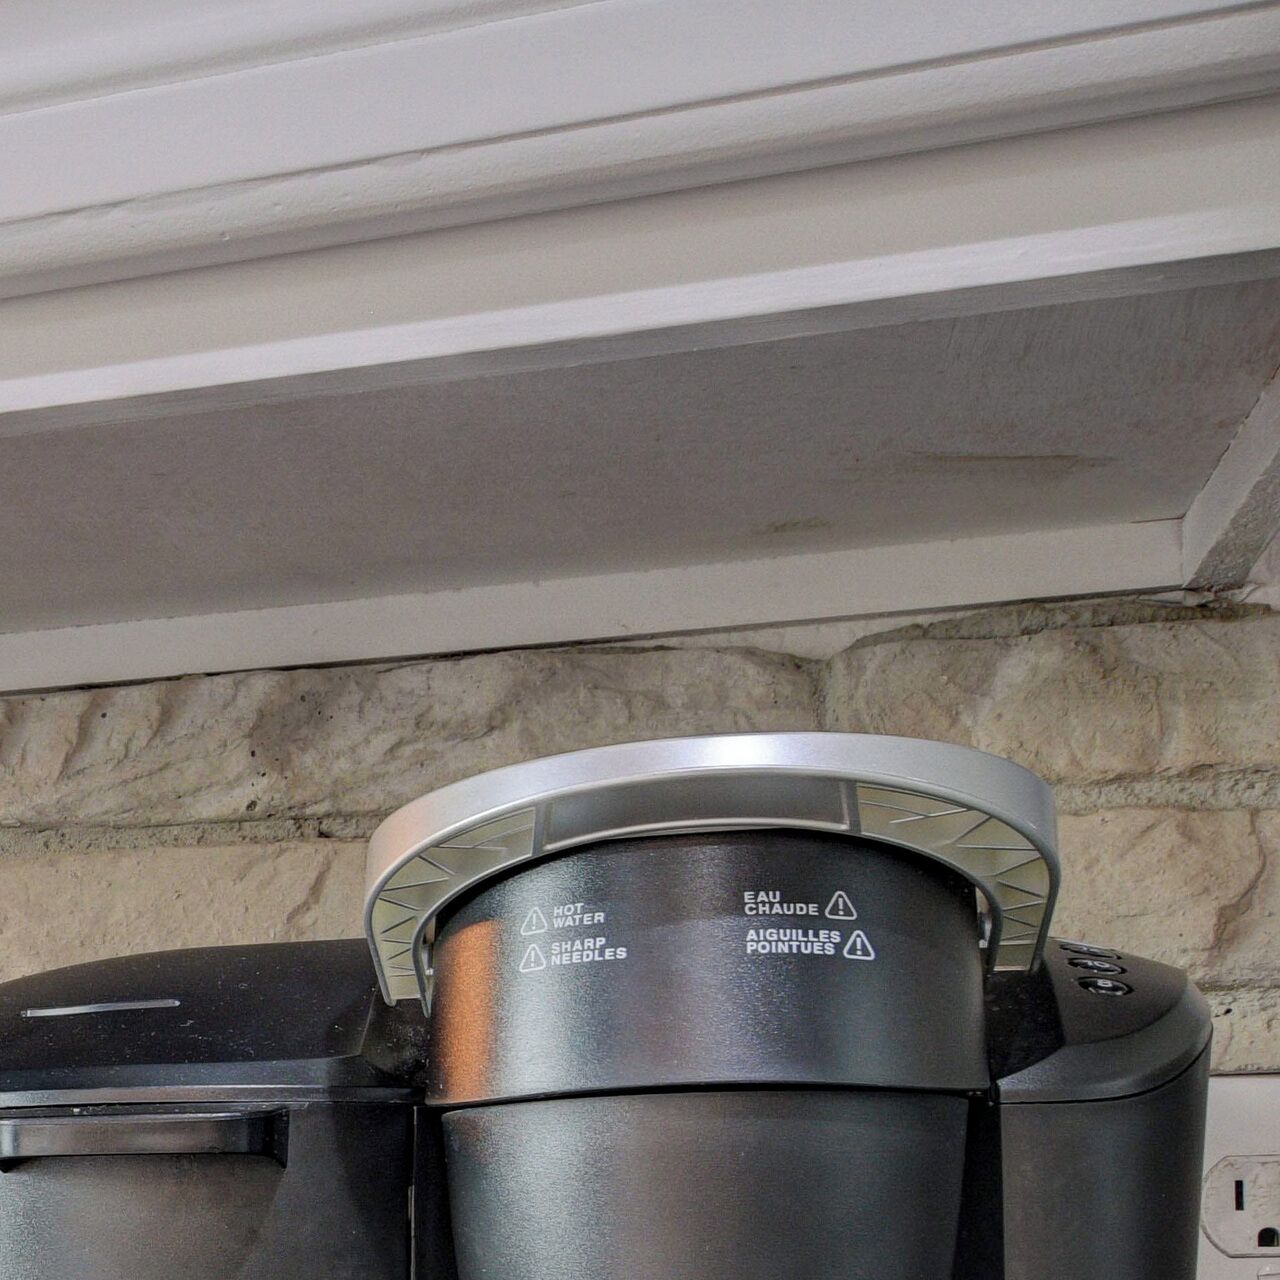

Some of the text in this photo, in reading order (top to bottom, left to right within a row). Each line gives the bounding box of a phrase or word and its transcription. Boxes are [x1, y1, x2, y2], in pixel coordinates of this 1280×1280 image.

[744, 890, 780, 903] EAU
[553, 903, 584, 917] HOT
[744, 903, 820, 916] CHAUDE
[552, 912, 605, 928] WATER
[746, 929, 841, 943] AIGUILLES
[551, 937, 606, 954] SHARP
[746, 941, 836, 955] POINTUES
[551, 947, 628, 966] NEEDLES
